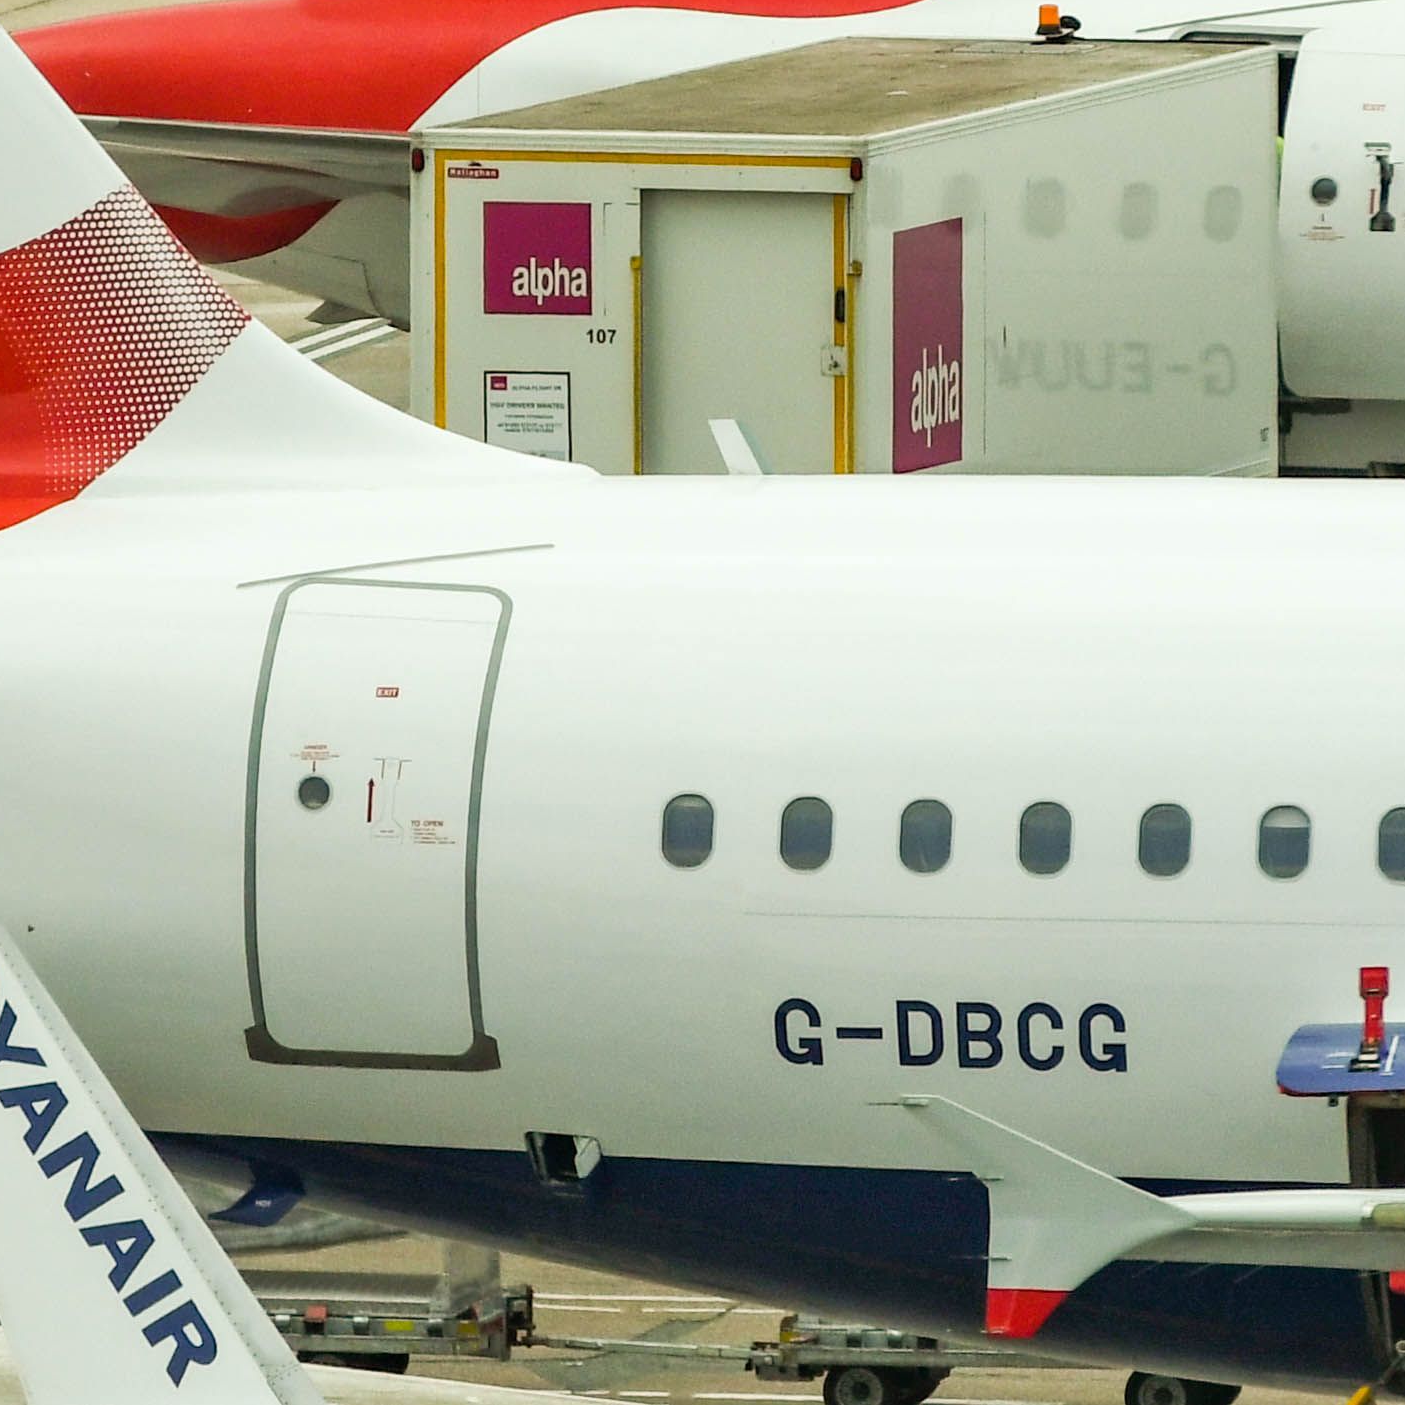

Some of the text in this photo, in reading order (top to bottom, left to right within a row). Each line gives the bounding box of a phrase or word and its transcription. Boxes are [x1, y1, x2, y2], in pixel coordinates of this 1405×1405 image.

[512, 256, 588, 306] alpha
[586, 328, 617, 344] 107
[910, 344, 961, 449] alpha
[377, 687, 399, 697] EXIT
[774, 997, 1128, 1073] G-DBCG
